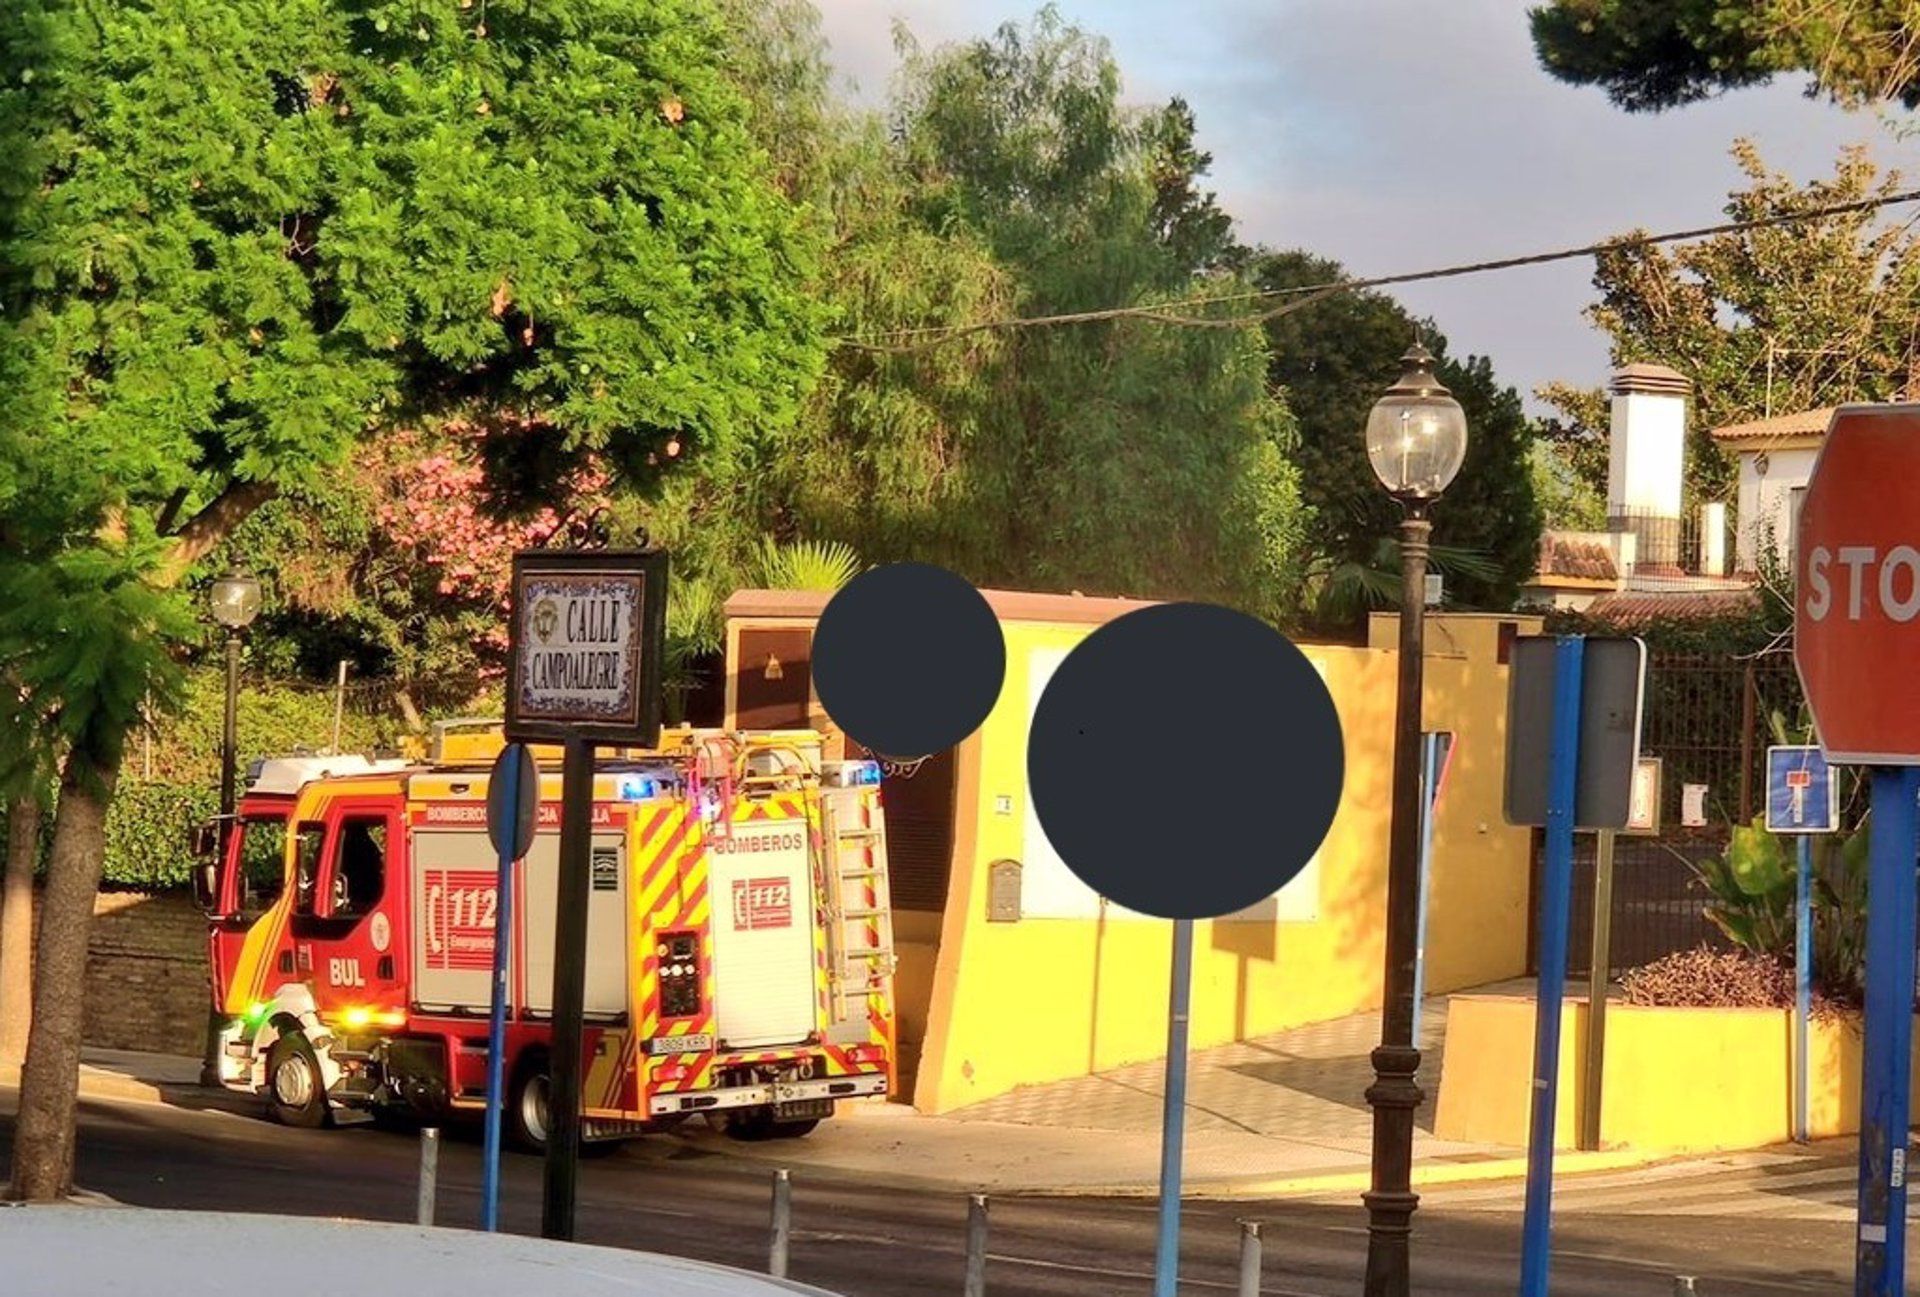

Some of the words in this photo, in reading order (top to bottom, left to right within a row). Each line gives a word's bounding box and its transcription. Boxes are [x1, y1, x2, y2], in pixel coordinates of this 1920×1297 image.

[1806, 546, 1920, 621] STO
[567, 600, 620, 643] CALLE
[532, 651, 620, 690] CAMPOALEGRE
[714, 833, 802, 855] BOMBEROS
[449, 887, 498, 928] 112
[751, 887, 789, 908] 112
[329, 957, 366, 987] BUL
